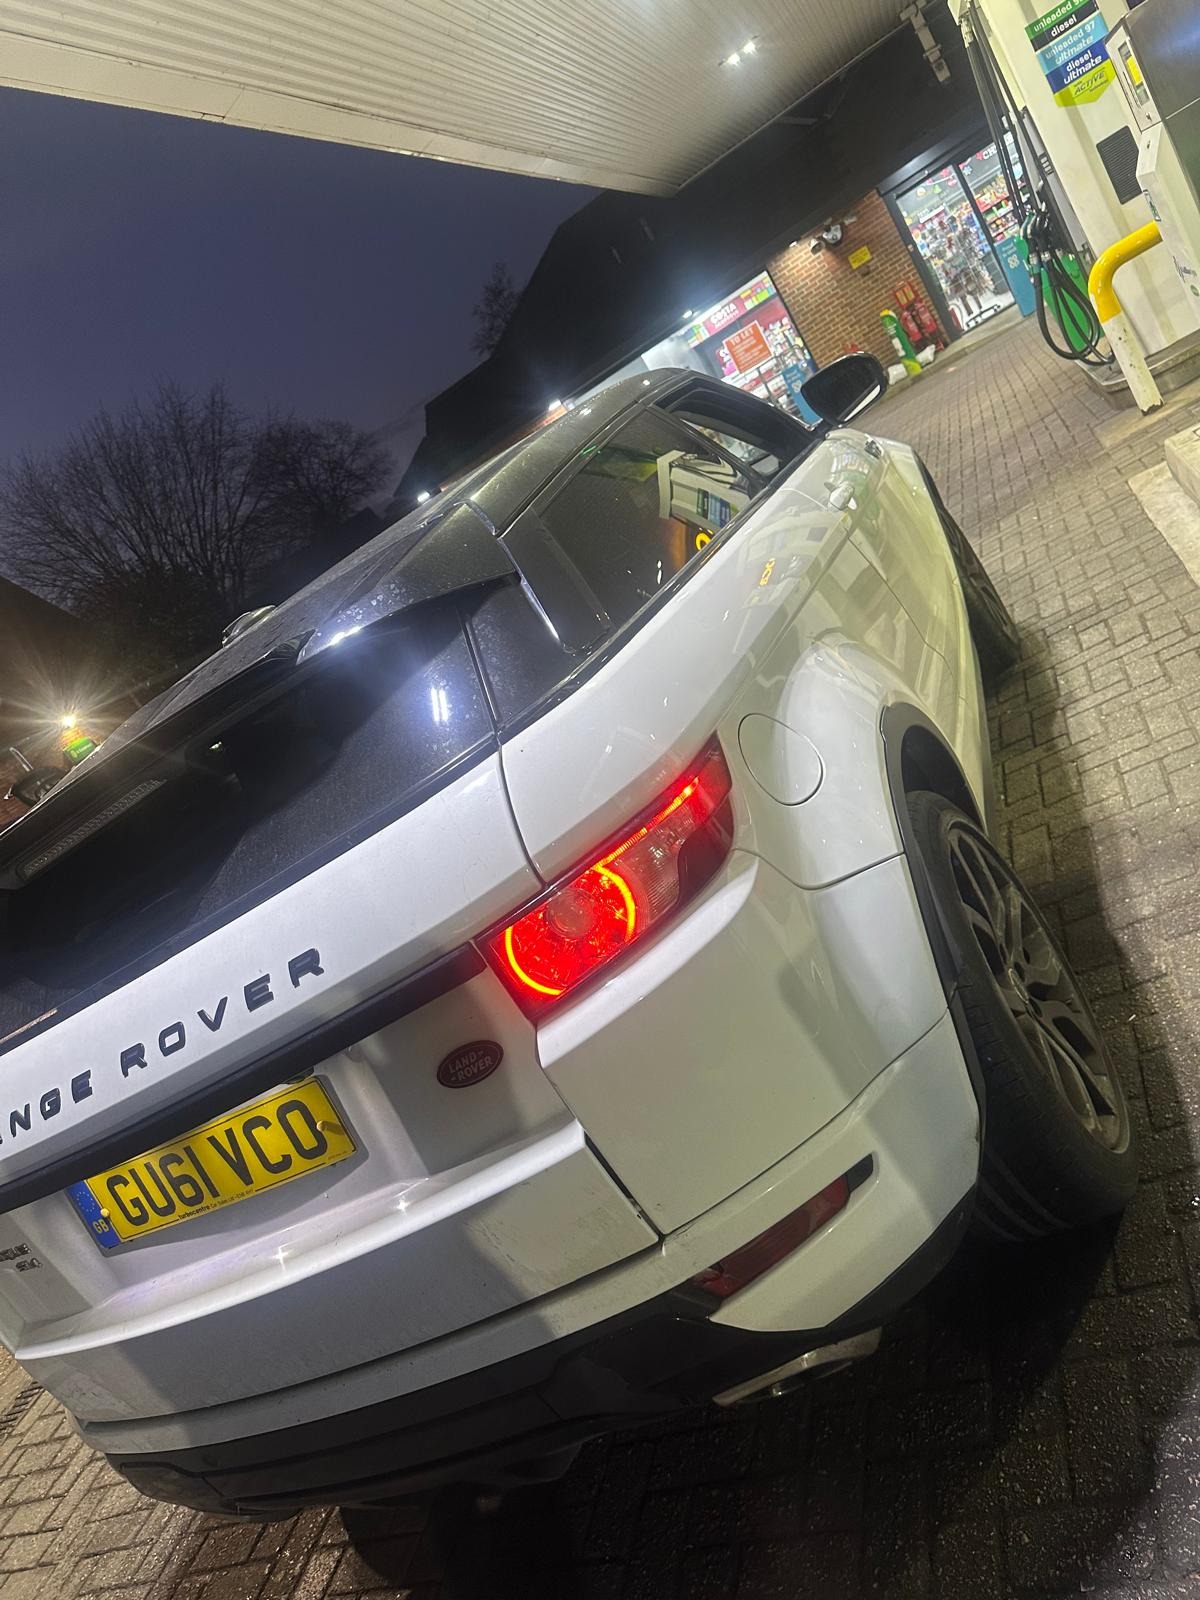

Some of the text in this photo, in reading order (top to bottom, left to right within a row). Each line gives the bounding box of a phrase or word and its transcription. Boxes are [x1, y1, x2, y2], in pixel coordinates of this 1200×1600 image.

[1033, 1, 1073, 32] unleaded
[1050, 14, 1077, 37] diesel
[1045, 20, 1096, 59] unleaded 97
[1055, 35, 1094, 65] ultimate
[1063, 55, 1102, 85] ultimate
[1066, 49, 1092, 72] diesel
[0, 947, 325, 1145] NGE ROVER
[106, 1100, 329, 1227] GU61 VCO
[91, 1218, 111, 1234] GB
